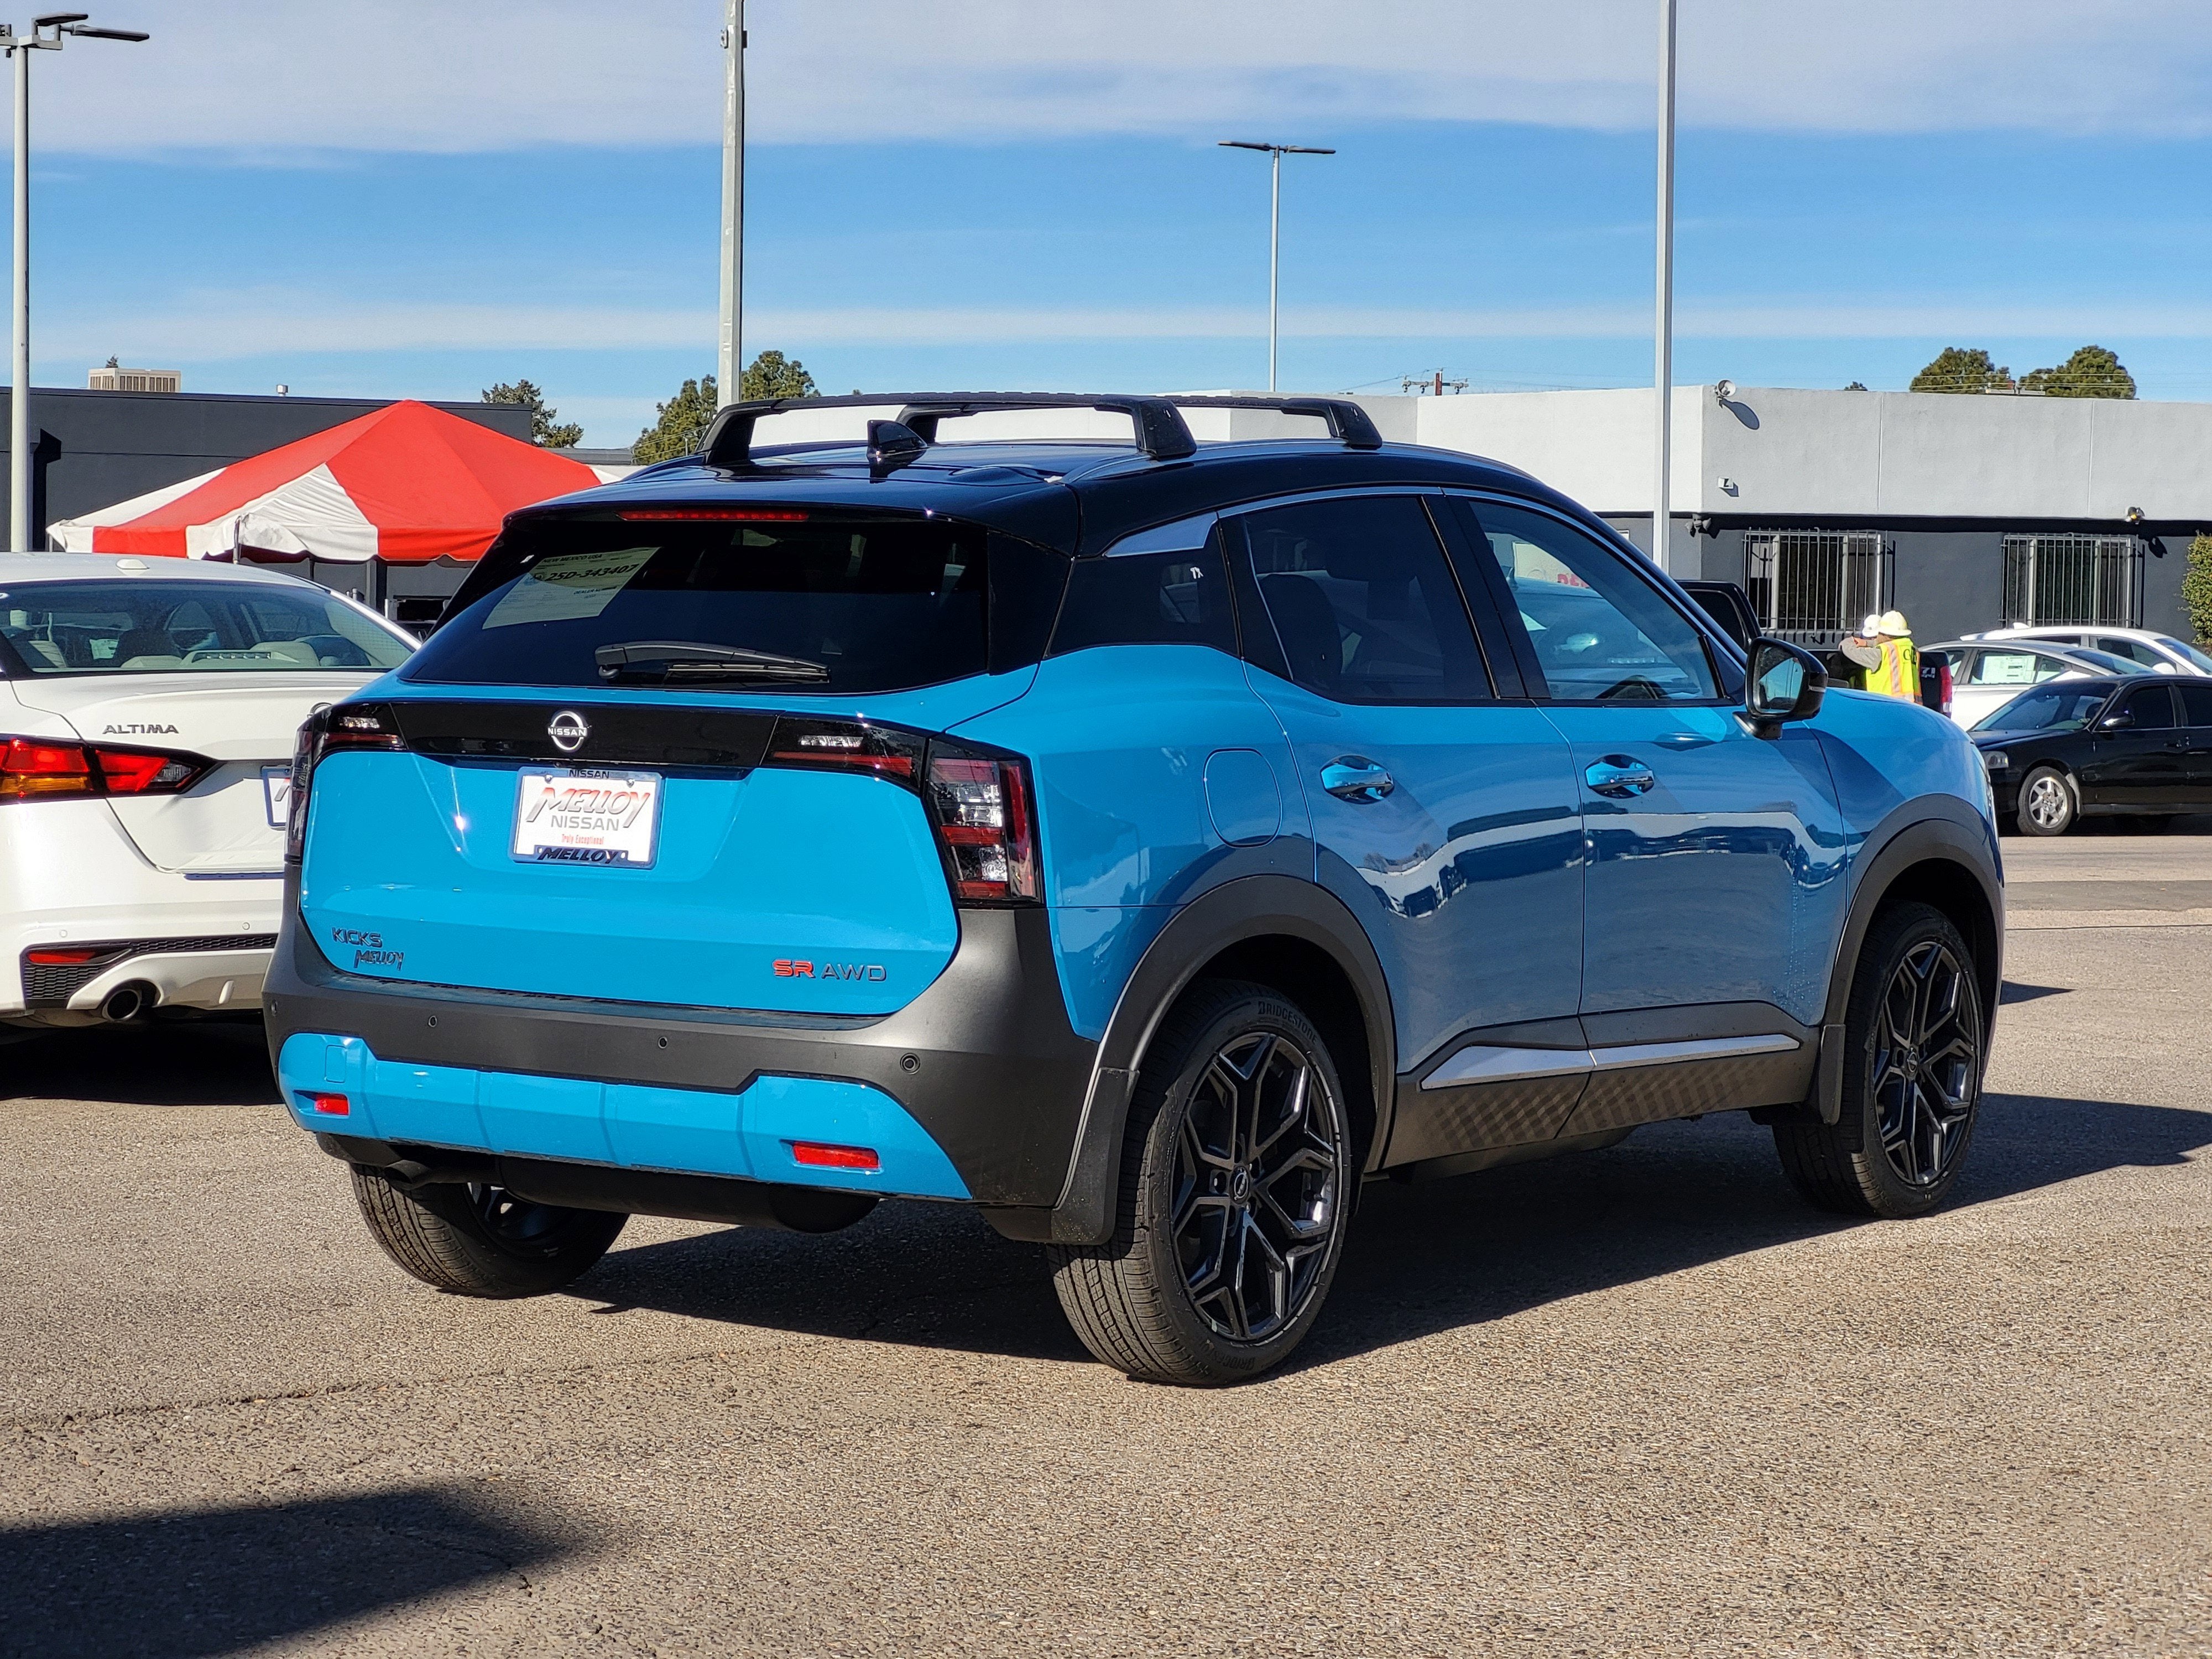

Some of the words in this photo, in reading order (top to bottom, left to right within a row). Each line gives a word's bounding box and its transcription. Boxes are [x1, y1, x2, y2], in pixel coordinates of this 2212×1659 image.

[545, 564, 640, 581] 25D-343407
[102, 724, 179, 734] ALTIMA
[547, 728, 587, 737] NISSAN
[568, 769, 609, 779] NISSAN
[525, 787, 651, 828] MELLOY
[551, 815, 619, 831] NISSAN
[537, 847, 619, 864] MELLOY
[332, 927, 383, 948] KICKS
[353, 950, 405, 972] MELLOY
[773, 959, 816, 979] SR
[821, 963, 888, 982] AWD
[1258, 1001, 1317, 1045] BRIDGESTONE
